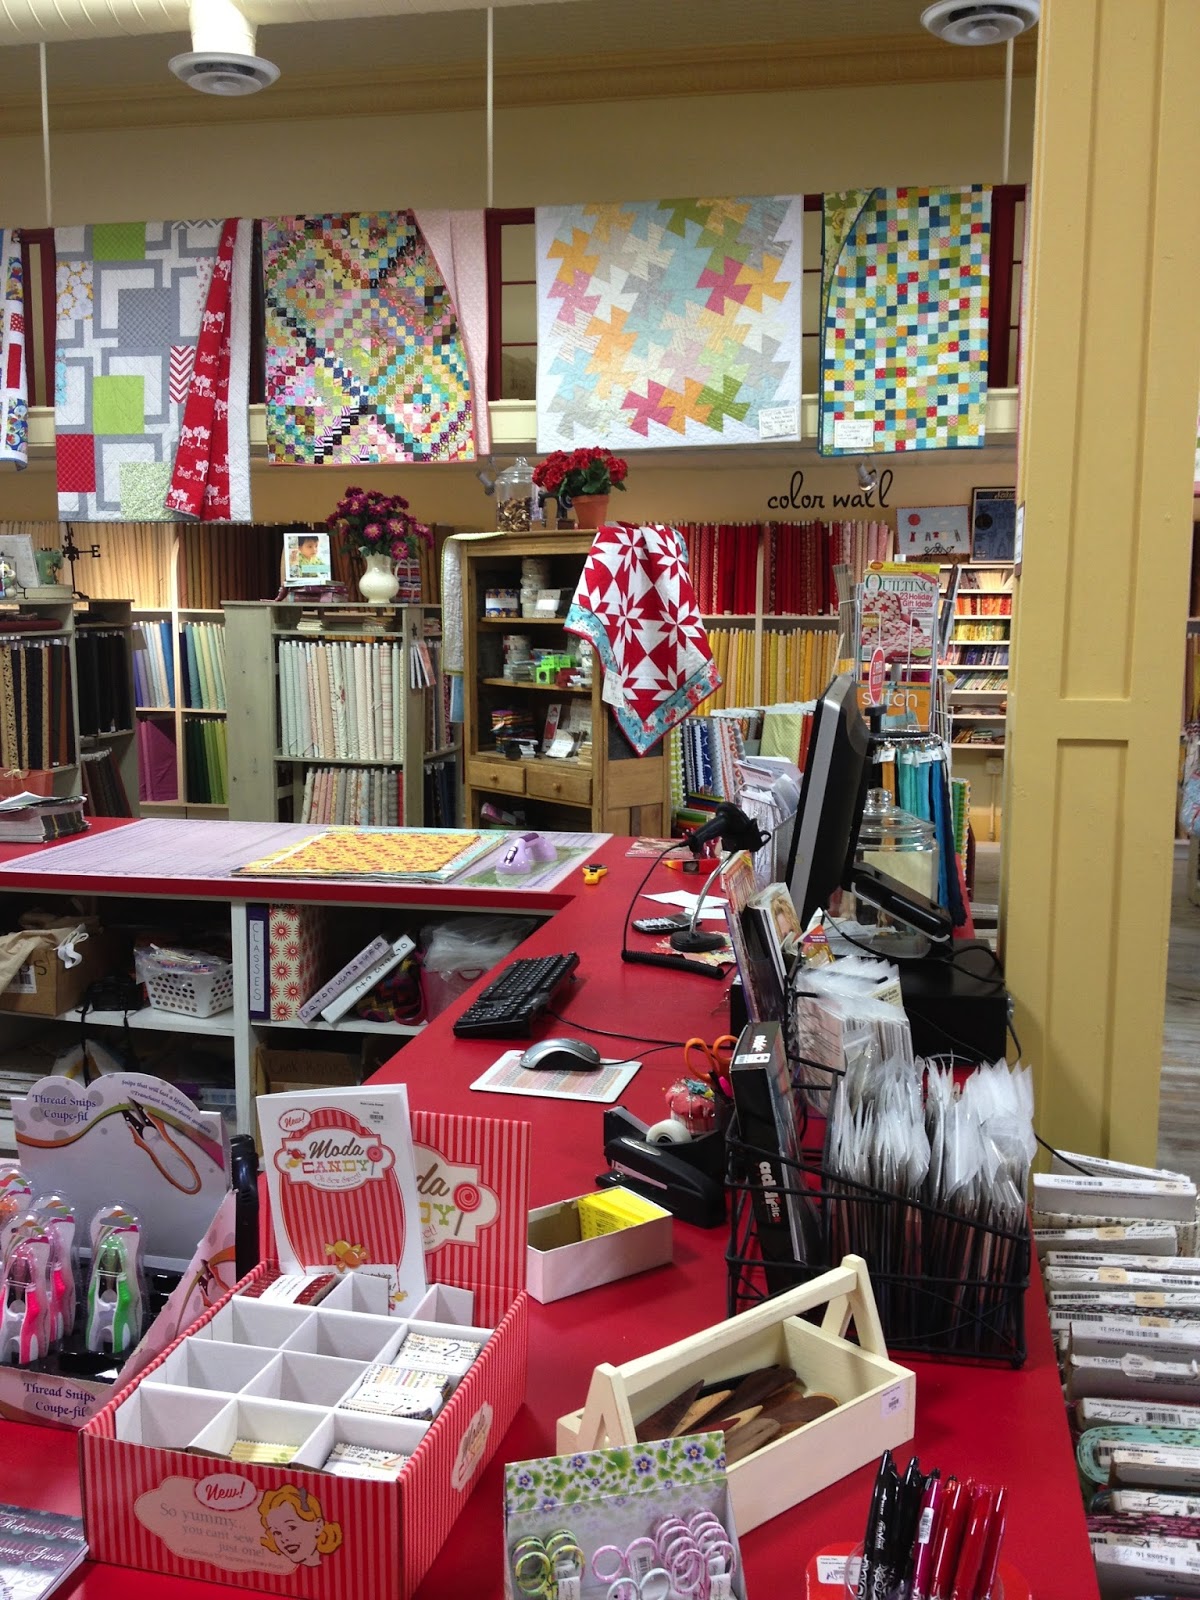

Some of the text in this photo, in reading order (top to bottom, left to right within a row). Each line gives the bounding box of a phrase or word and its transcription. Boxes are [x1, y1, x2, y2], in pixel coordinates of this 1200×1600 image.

[767, 469, 893, 509] color wall
[866, 573, 934, 593] QUILTING
[909, 592, 933, 602] Holiday
[916, 600, 933, 608] Ideas
[861, 690, 918, 708] sitch
[251, 922, 262, 1001] CLASSES
[32, 1094, 97, 1110] Thread Snips
[43, 1109, 88, 1124] Coupe-fil
[284, 1112, 306, 1128] New!
[309, 1137, 364, 1159] Moda
[302, 1159, 369, 1174] CANDY
[416, 1162, 451, 1197] da
[23, 1383, 96, 1404] Thread Snips
[35, 1401, 86, 1419] Coupe-fil
[205, 1481, 245, 1501] New!
[160, 1502, 177, 1517] So
[0, 1517, 50, 1535] Reference
[182, 1524, 202, 1537] you
[25, 1546, 66, 1562] Guide
[218, 1543, 238, 1553] just
